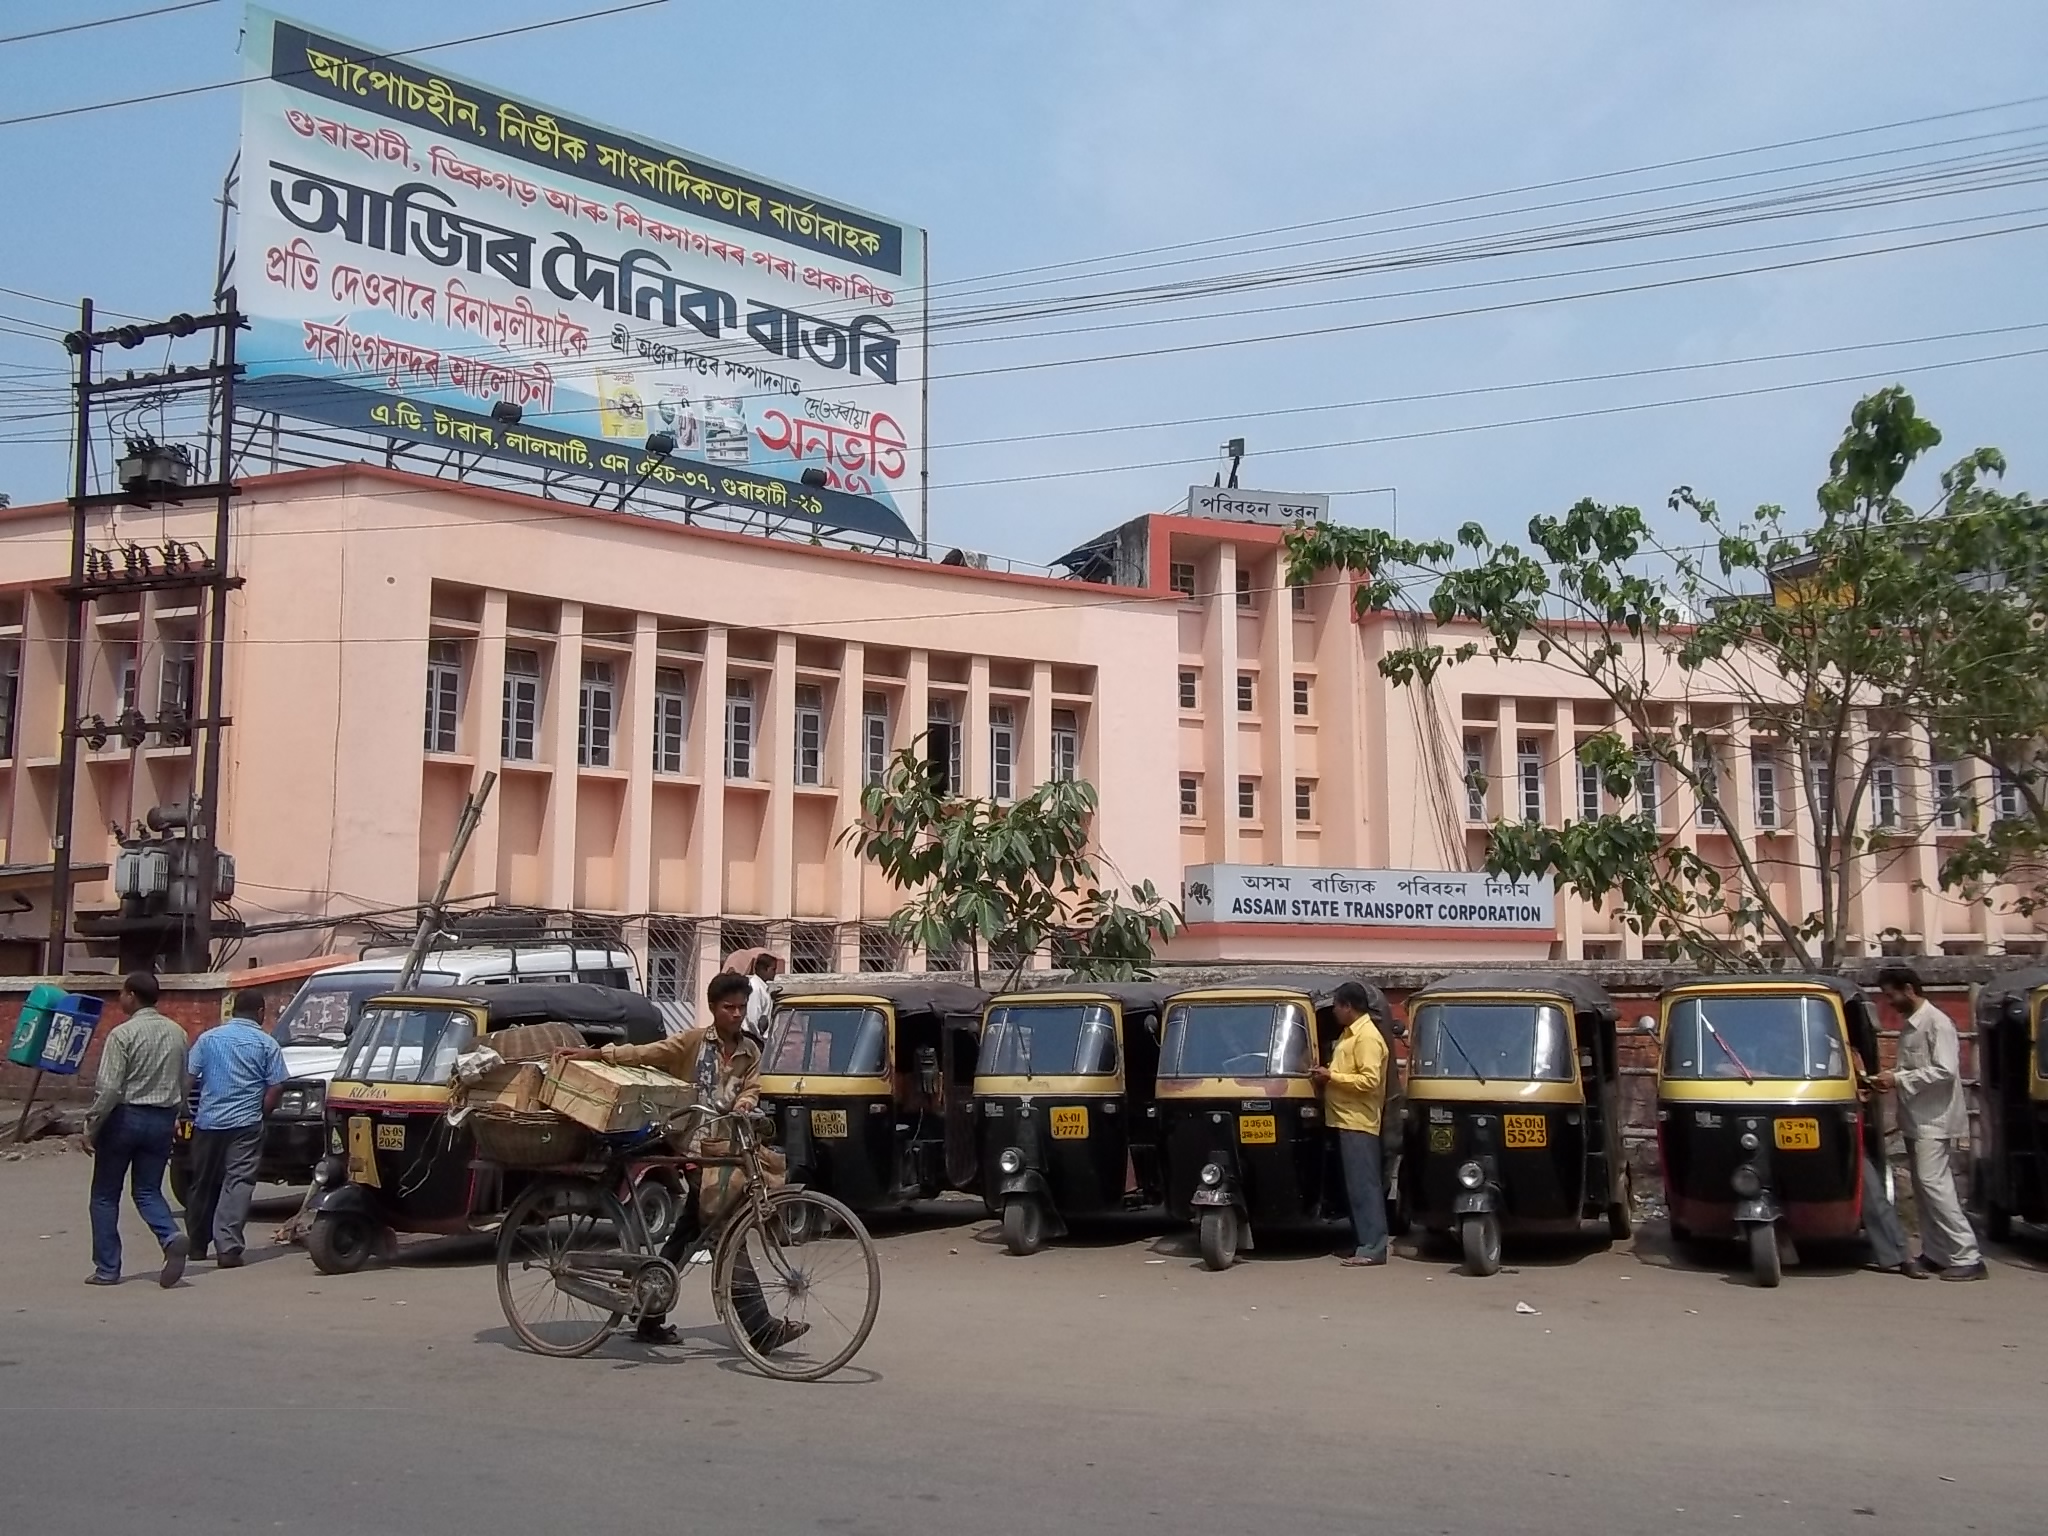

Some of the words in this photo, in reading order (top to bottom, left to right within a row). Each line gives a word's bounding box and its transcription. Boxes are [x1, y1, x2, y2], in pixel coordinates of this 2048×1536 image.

[306, 47, 487, 136] আপোচহীন,
[496, 104, 587, 164] নিৰ্ভীক
[597, 144, 761, 221] সাংবাদিকতাৰ
[768, 200, 881, 256] বাৰ্তাবাহক
[285, 109, 420, 172] গুৱাহাটী,
[542, 187, 608, 223] আৰু
[614, 201, 746, 266] শিৱসাগৰৰ
[752, 251, 797, 283] পৰা
[803, 266, 895, 307] প্ৰকাশিত
[266, 238, 320, 290] প্ৰতি
[331, 265, 437, 322] দেওবাৰে
[269, 160, 536, 288] আজিৰ
[542, 231, 737, 339] দৈনিক
[747, 299, 900, 385] বাতৰি
[447, 354, 555, 411] আলোচনী
[504, 431, 593, 470] লালমাটি,
[600, 454, 629, 475] এন
[1232, 898, 1287, 916] ASSAM
[1291, 899, 1340, 917] STATE
[1344, 901, 1433, 920] TRANSPORT
[1438, 904, 1541, 922] CORPORATION
[1240, 876, 1292, 892] অসম
[1484, 877, 1531, 897] নিগম
[1507, 1129, 1545, 1143] 5523
